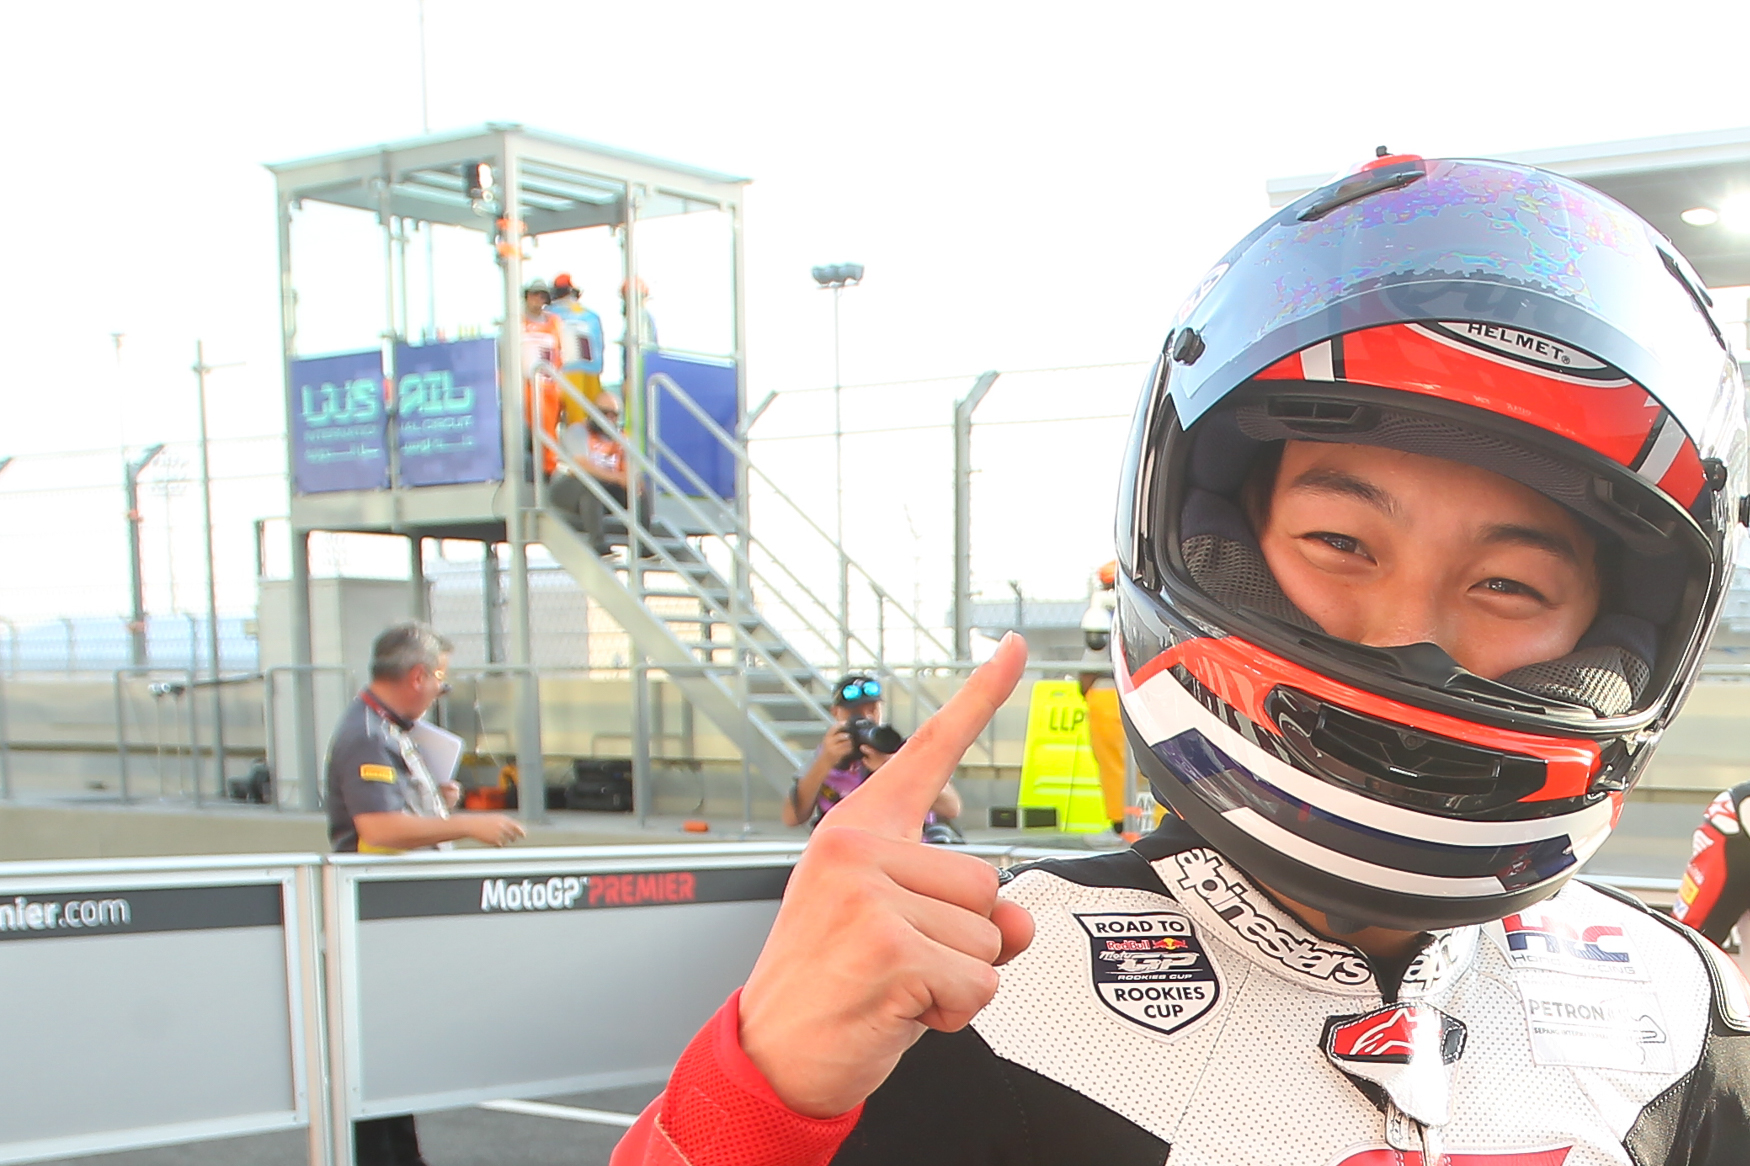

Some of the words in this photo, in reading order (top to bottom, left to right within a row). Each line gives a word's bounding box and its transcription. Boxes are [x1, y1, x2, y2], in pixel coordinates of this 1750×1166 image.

[1466, 322, 1566, 361] HELMET
[1050, 709, 1085, 732] LLP
[588, 871, 698, 907] PREMIER
[1094, 920, 1154, 934] ROAD
[1157, 920, 1186, 933] TO
[1176, 847, 1375, 985] alpinestars
[1114, 986, 1206, 1002] ROOKIES
[1144, 1004, 1184, 1019] CUP
